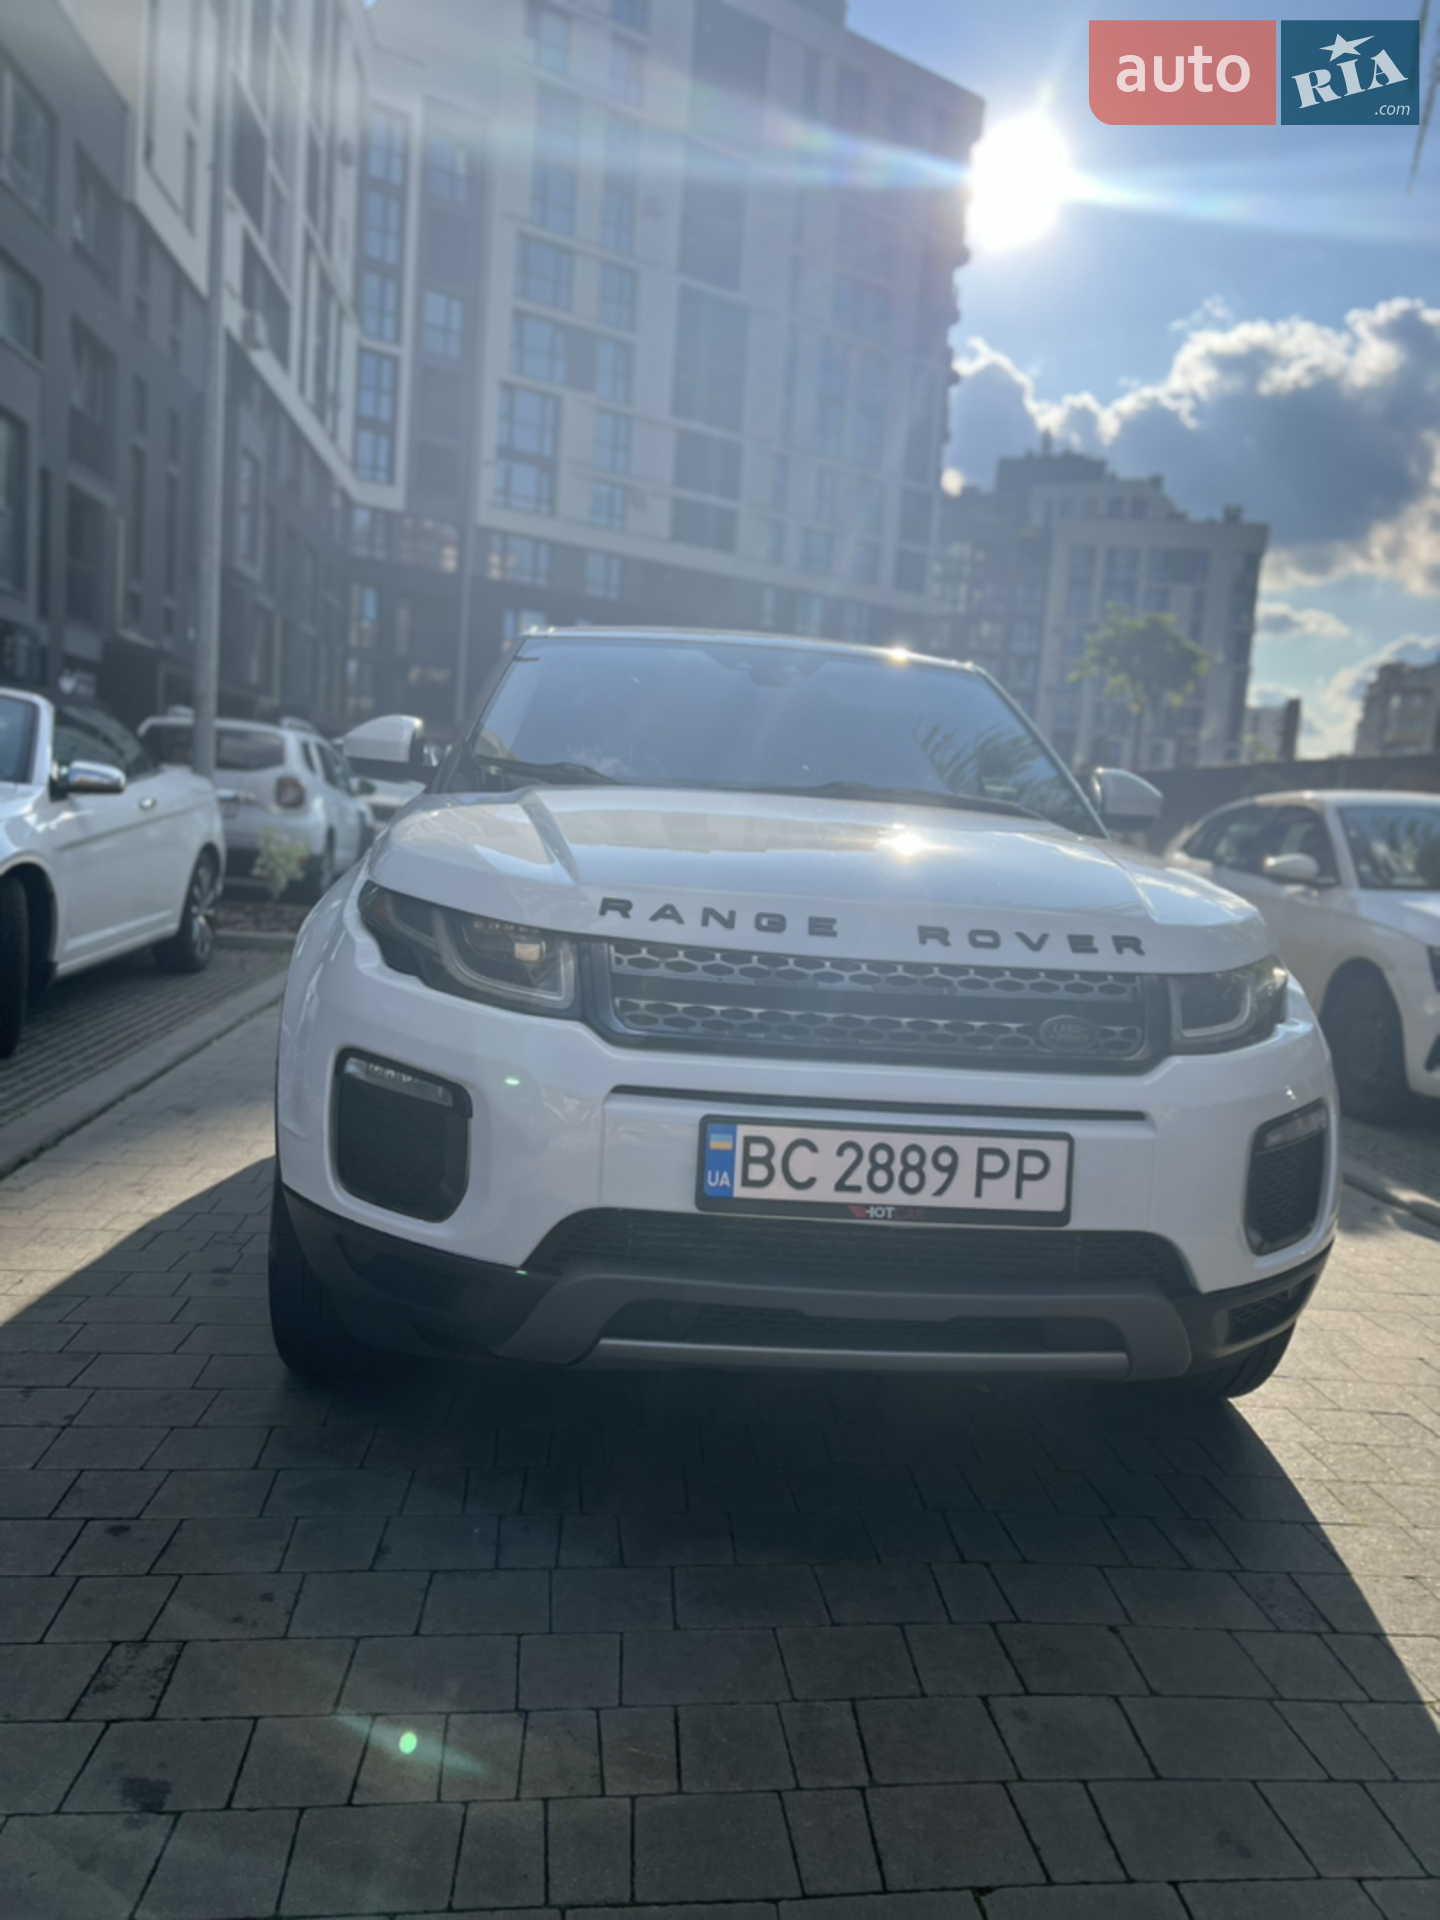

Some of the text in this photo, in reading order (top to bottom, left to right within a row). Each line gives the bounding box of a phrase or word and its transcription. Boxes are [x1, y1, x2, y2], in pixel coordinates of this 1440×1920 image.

[599, 897, 1146, 956] RANGE ROVER
[707, 1170, 731, 1188] UA
[740, 1135, 1051, 1199] BC 2889 PP
